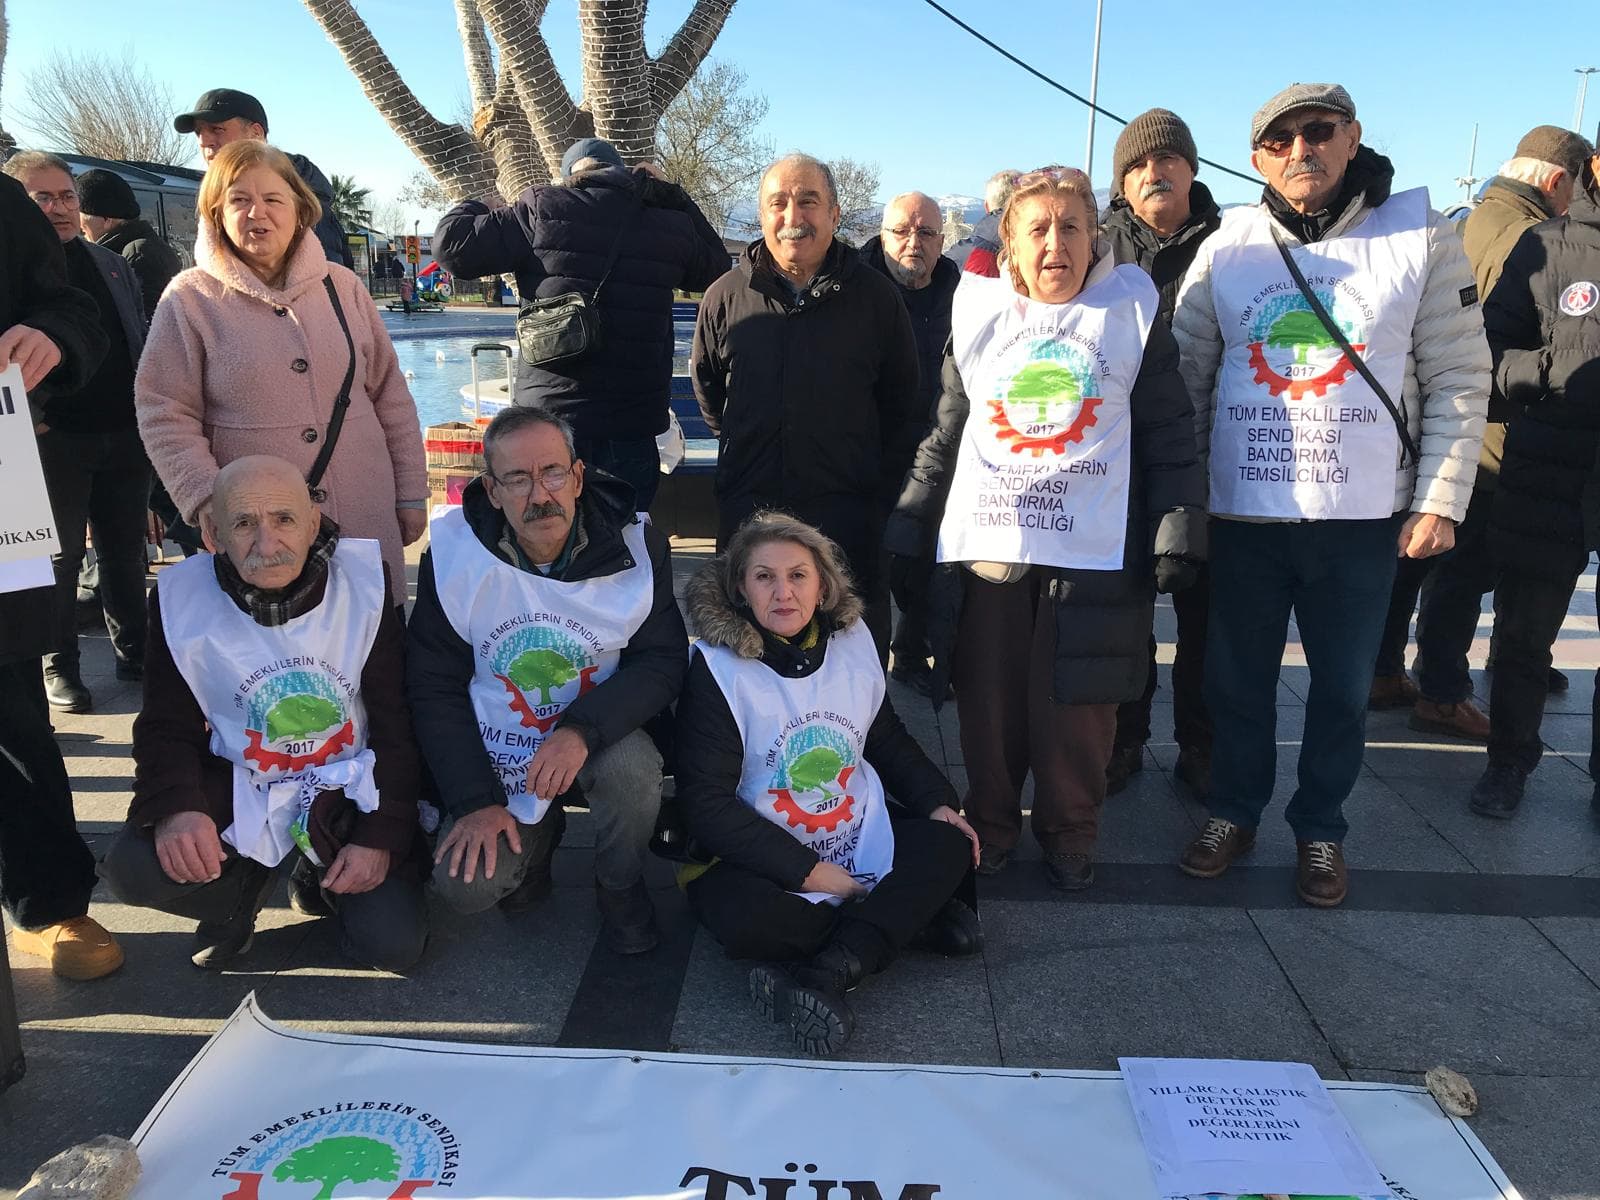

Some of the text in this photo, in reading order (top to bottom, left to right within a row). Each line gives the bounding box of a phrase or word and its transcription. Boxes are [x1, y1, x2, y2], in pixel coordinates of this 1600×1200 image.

[1239, 305, 1253, 327] TÜM
[1328, 276, 1374, 321] SENDİKASI
[1284, 366, 1315, 377] 2017
[1227, 405, 1377, 423] TÜM EMEKLİLERİN
[1026, 425, 1055, 435] 2017
[1248, 427, 1341, 444] SENDİKASI
[1247, 447, 1339, 463] BANDIRMA
[1239, 465, 1350, 484] TEMSİLCİLİĞİ
[980, 476, 1068, 495] SENDİKASI
[978, 494, 1064, 512] BANDIRMA
[972, 510, 1074, 532] TEMSİLCİLİĞİ
[480, 640, 492, 659] TÜM
[492, 613, 561, 640] EMEKLİLERİN
[240, 656, 314, 693] EMEKLİLERİN
[534, 704, 560, 717] 2017
[285, 740, 315, 754] 2017
[815, 797, 839, 813] 2017
[1148, 1084, 1307, 1098] YILLARCA ÇALIŞTIK
[1185, 1095, 1280, 1107] ÜRETTİK BU
[1202, 1106, 1275, 1118] ÜLKENİN
[1188, 1117, 1302, 1129] DEĞERLERİNİ
[1208, 1129, 1293, 1142] YARATTIK
[211, 1100, 462, 1188] TÜM EMEKLİLERİN SENDİKASI
